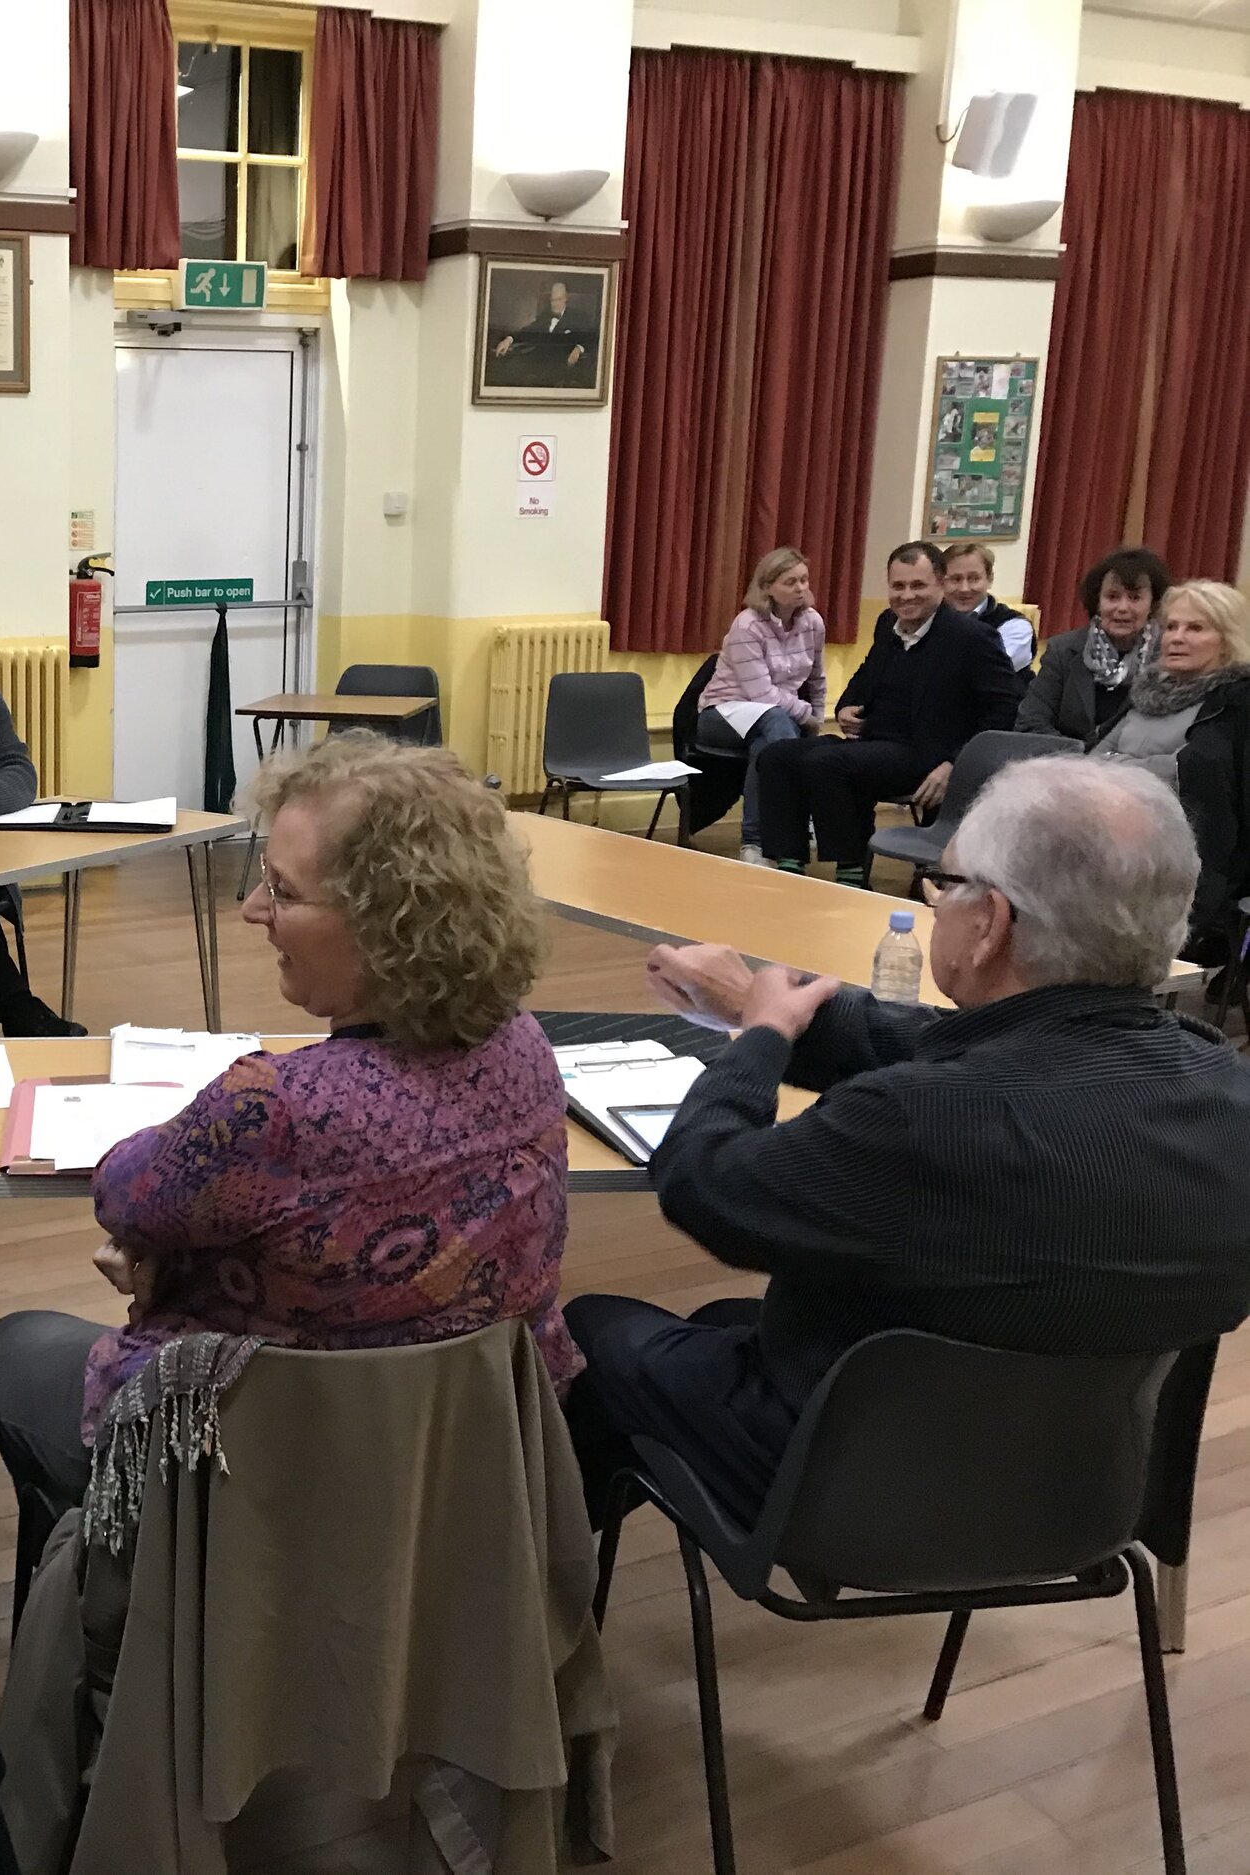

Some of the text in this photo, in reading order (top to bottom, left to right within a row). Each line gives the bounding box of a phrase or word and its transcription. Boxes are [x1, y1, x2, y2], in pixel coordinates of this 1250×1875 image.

[529, 497, 540, 505] No
[519, 507, 549, 516] Smoking
[167, 587, 251, 599] Push bar to open
